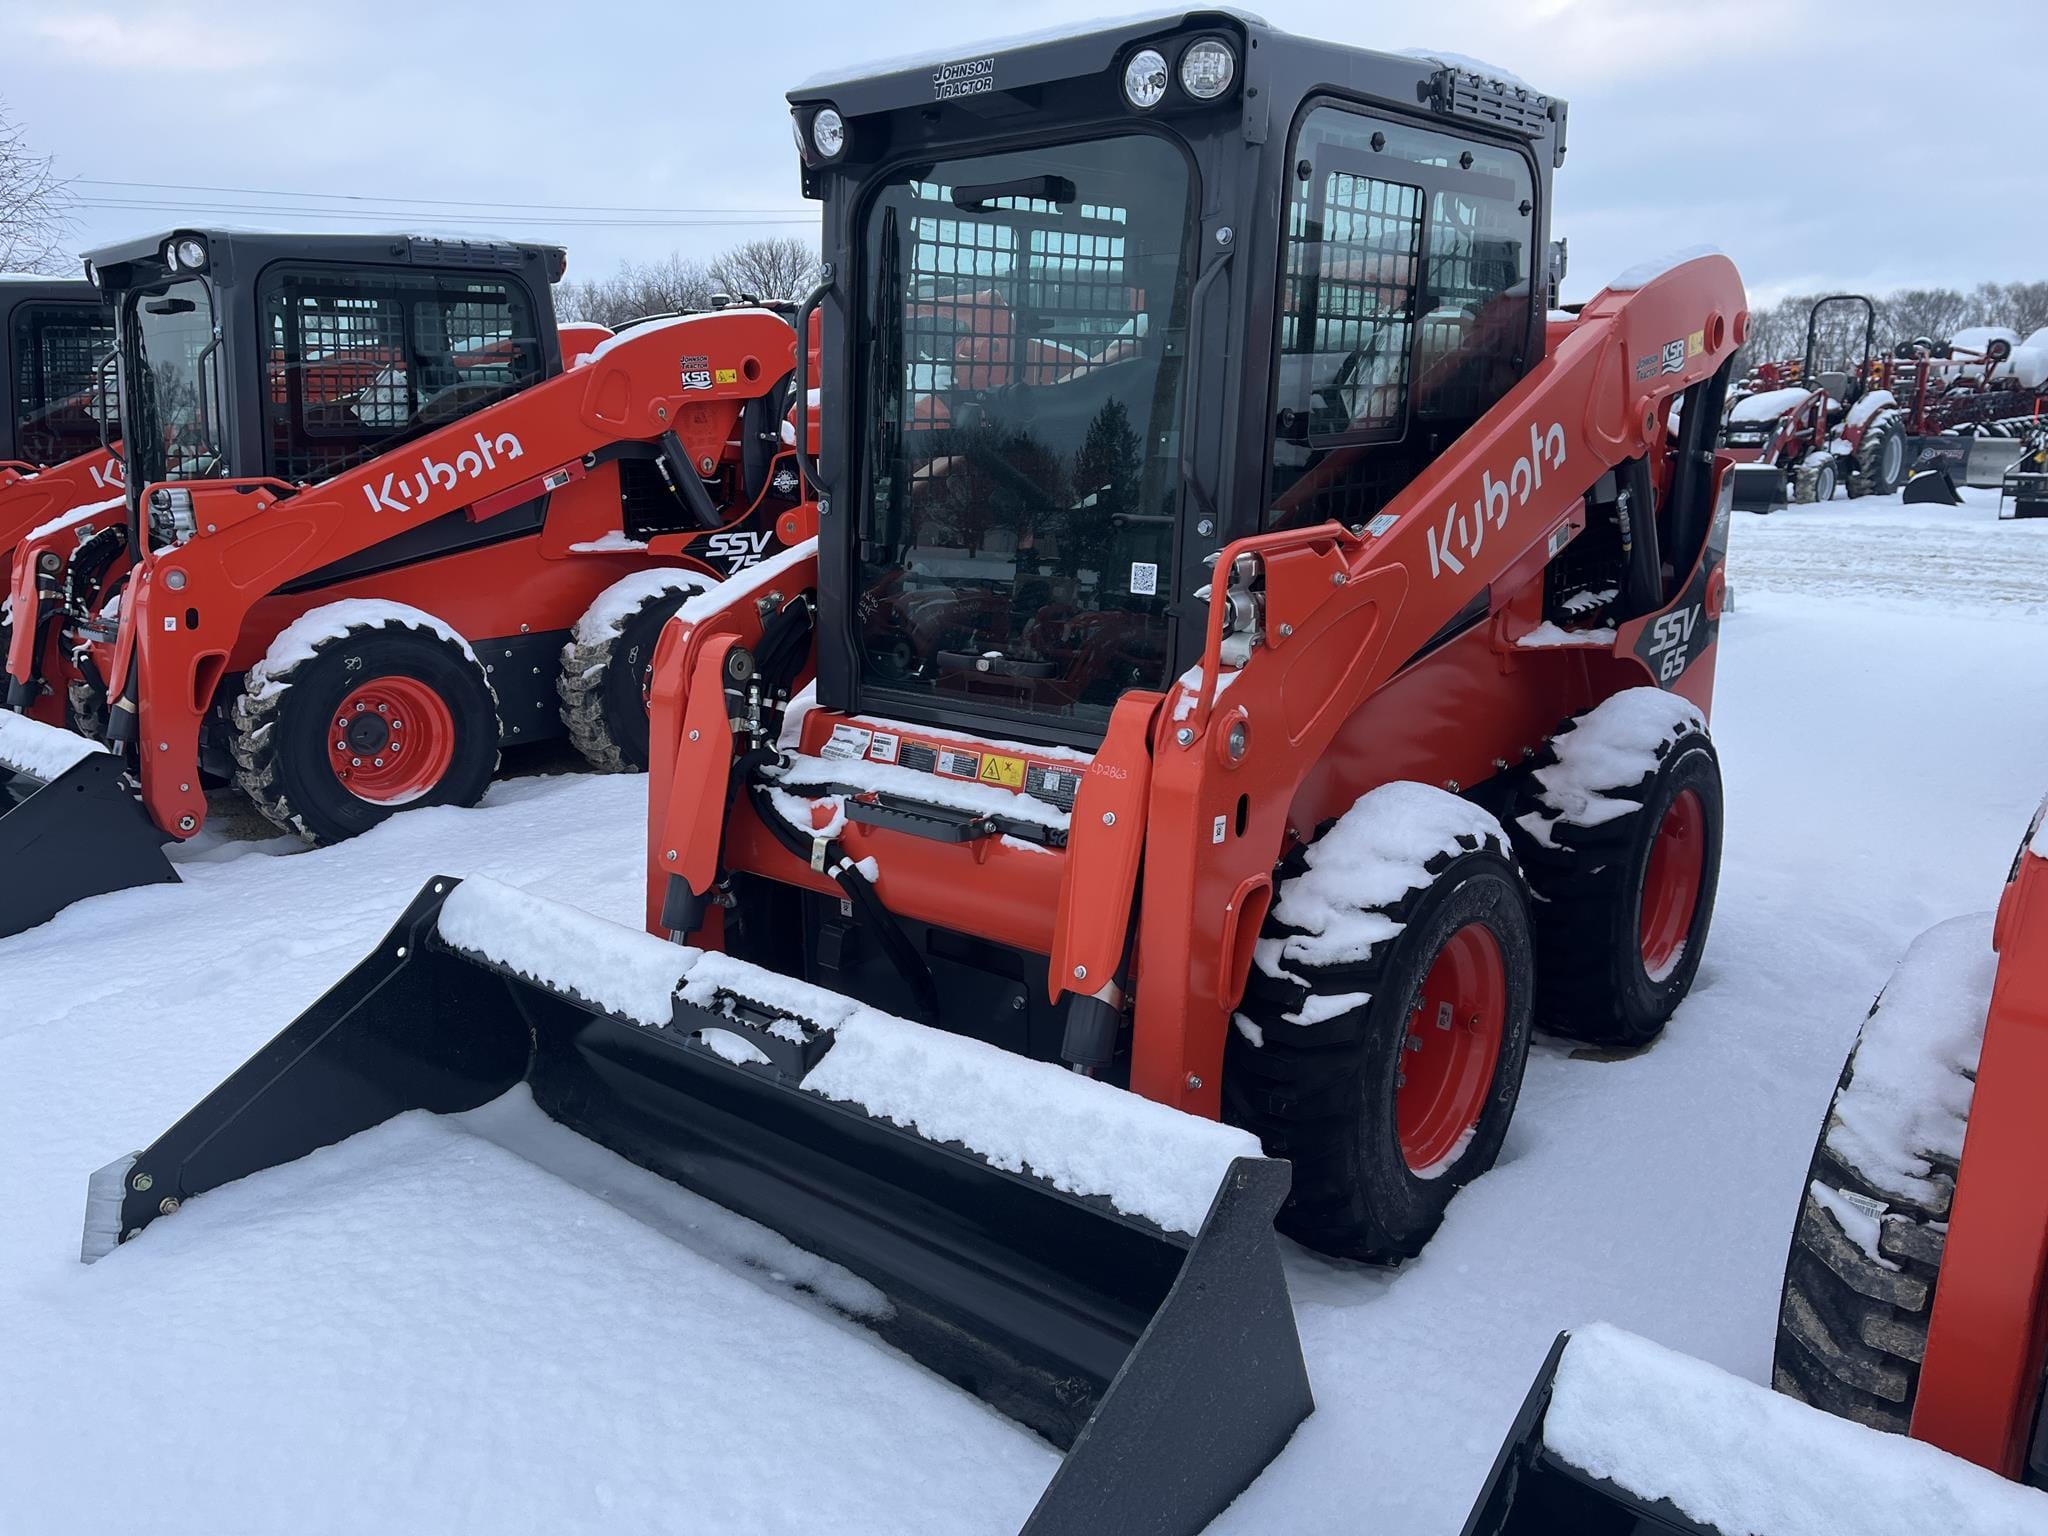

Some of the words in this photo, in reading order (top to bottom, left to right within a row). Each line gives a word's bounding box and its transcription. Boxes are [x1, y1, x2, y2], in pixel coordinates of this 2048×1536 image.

[933, 58, 994, 83] JOHNSON
[934, 77, 993, 99] TRACTOR
[1662, 339, 1685, 363] KSR
[682, 371, 710, 382] KSR
[362, 431, 524, 513] Kubota
[1426, 422, 1567, 579] Kubota
[705, 530, 773, 557] SSV
[1649, 603, 1701, 656] SSV
[1660, 644, 1689, 682] 65
